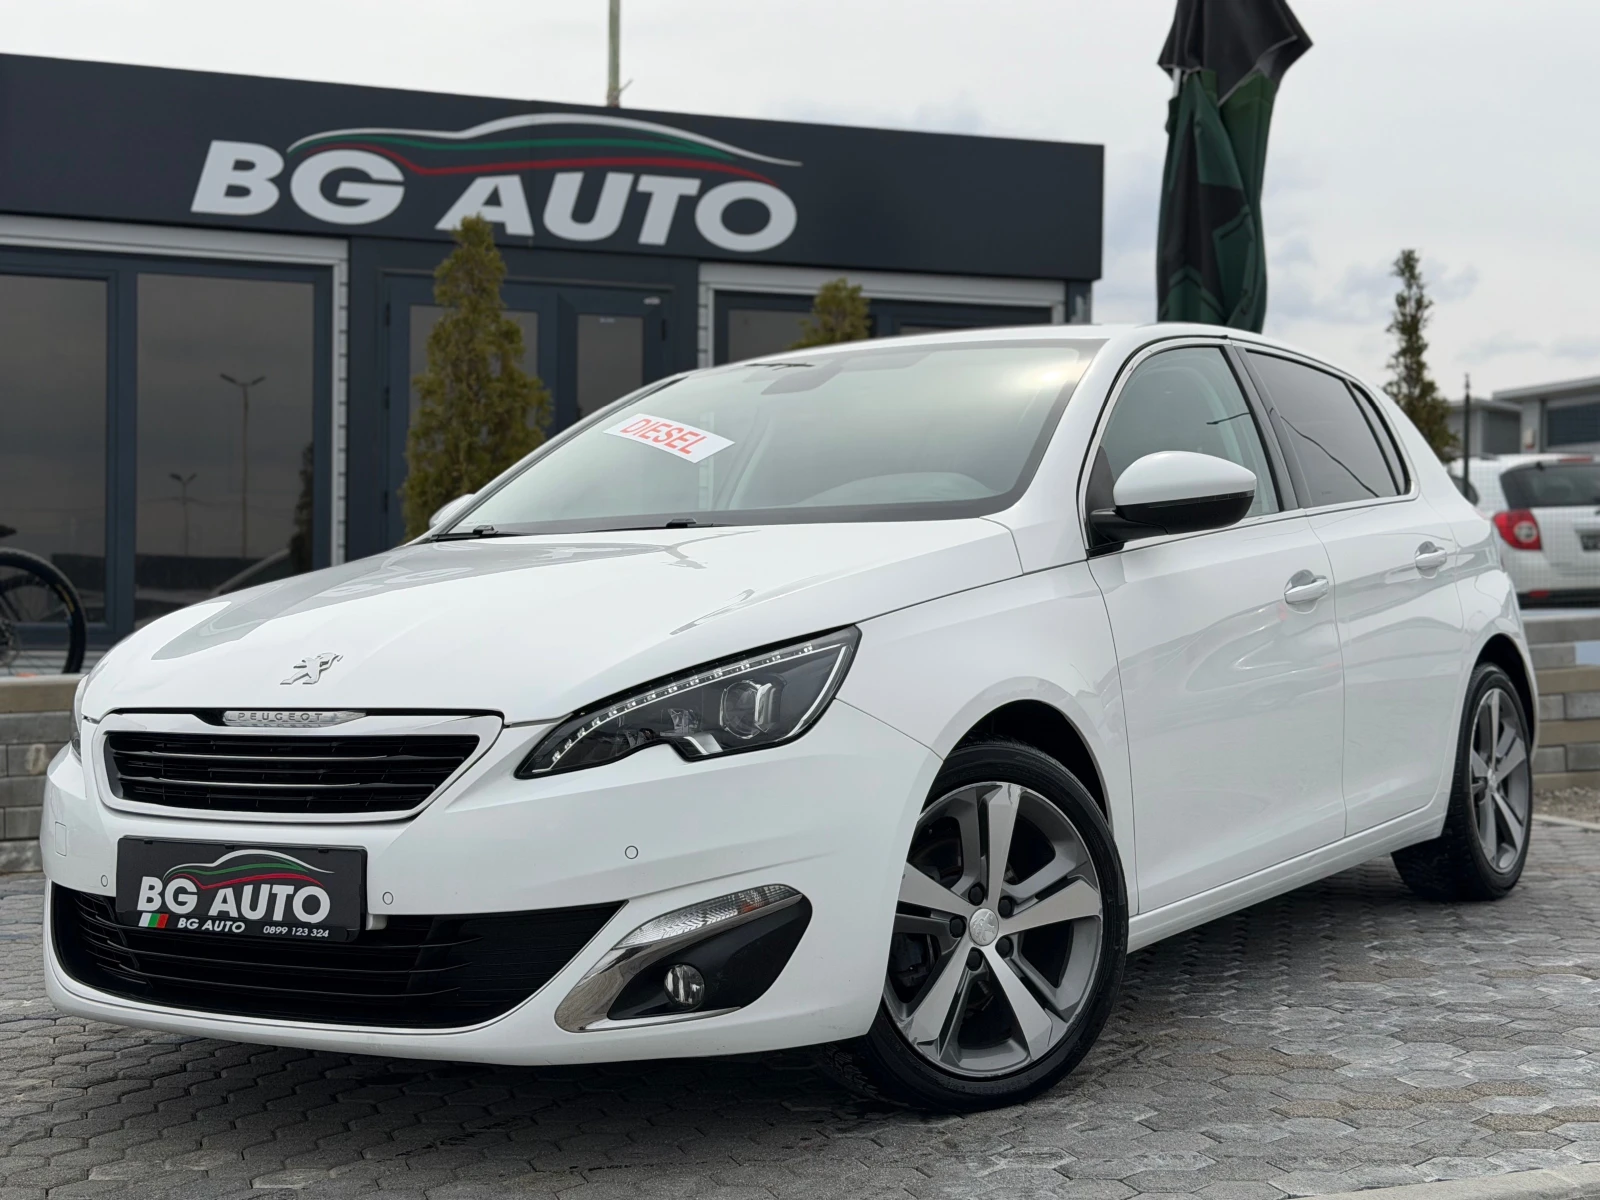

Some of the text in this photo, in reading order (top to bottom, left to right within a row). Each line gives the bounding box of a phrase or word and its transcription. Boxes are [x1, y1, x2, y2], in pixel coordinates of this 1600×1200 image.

[190, 140, 797, 252] BG AUTO
[620, 418, 707, 454] DIESEL
[238, 712, 323, 721] PEUGEOT
[137, 876, 331, 923] BG AUTO
[177, 918, 329, 938] BG AUTO 0899 123 324
